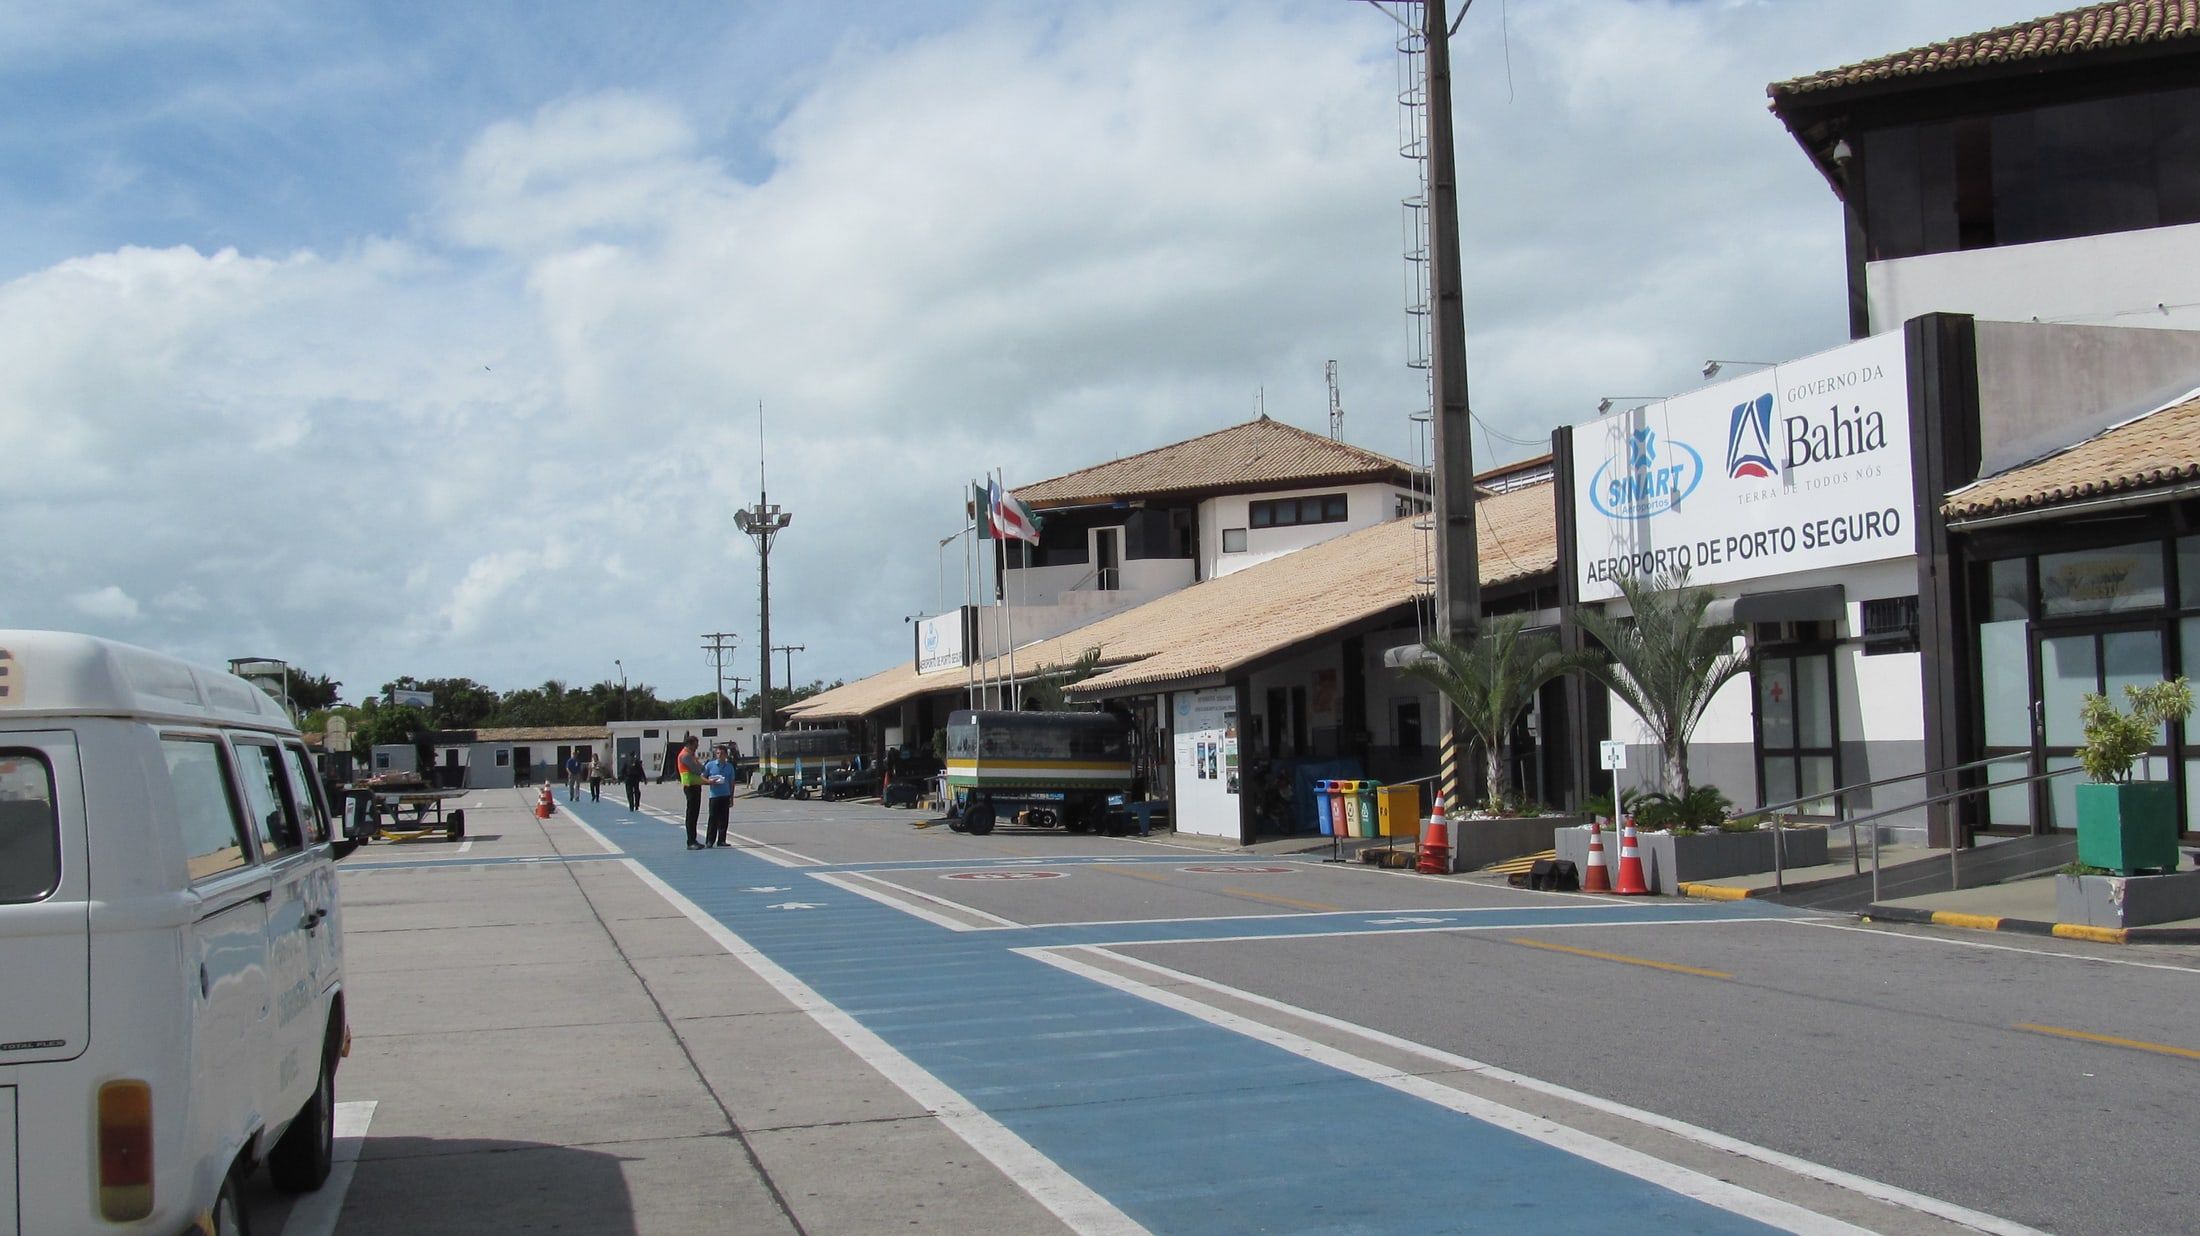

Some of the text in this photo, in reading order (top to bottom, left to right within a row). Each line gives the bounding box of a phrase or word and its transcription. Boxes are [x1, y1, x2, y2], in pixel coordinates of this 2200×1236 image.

[1787, 364, 1884, 402] GOVERNO DA
[1783, 404, 1888, 468] Bahia
[1609, 464, 1684, 507] SINART
[1738, 464, 1882, 505] TERRA DE TODOS NÓS
[1622, 498, 1669, 515] Aeroportos
[1587, 507, 1901, 584] AEROPORTO DE PORTO SEGURO
[36, 1040, 64, 1048] FLEX
